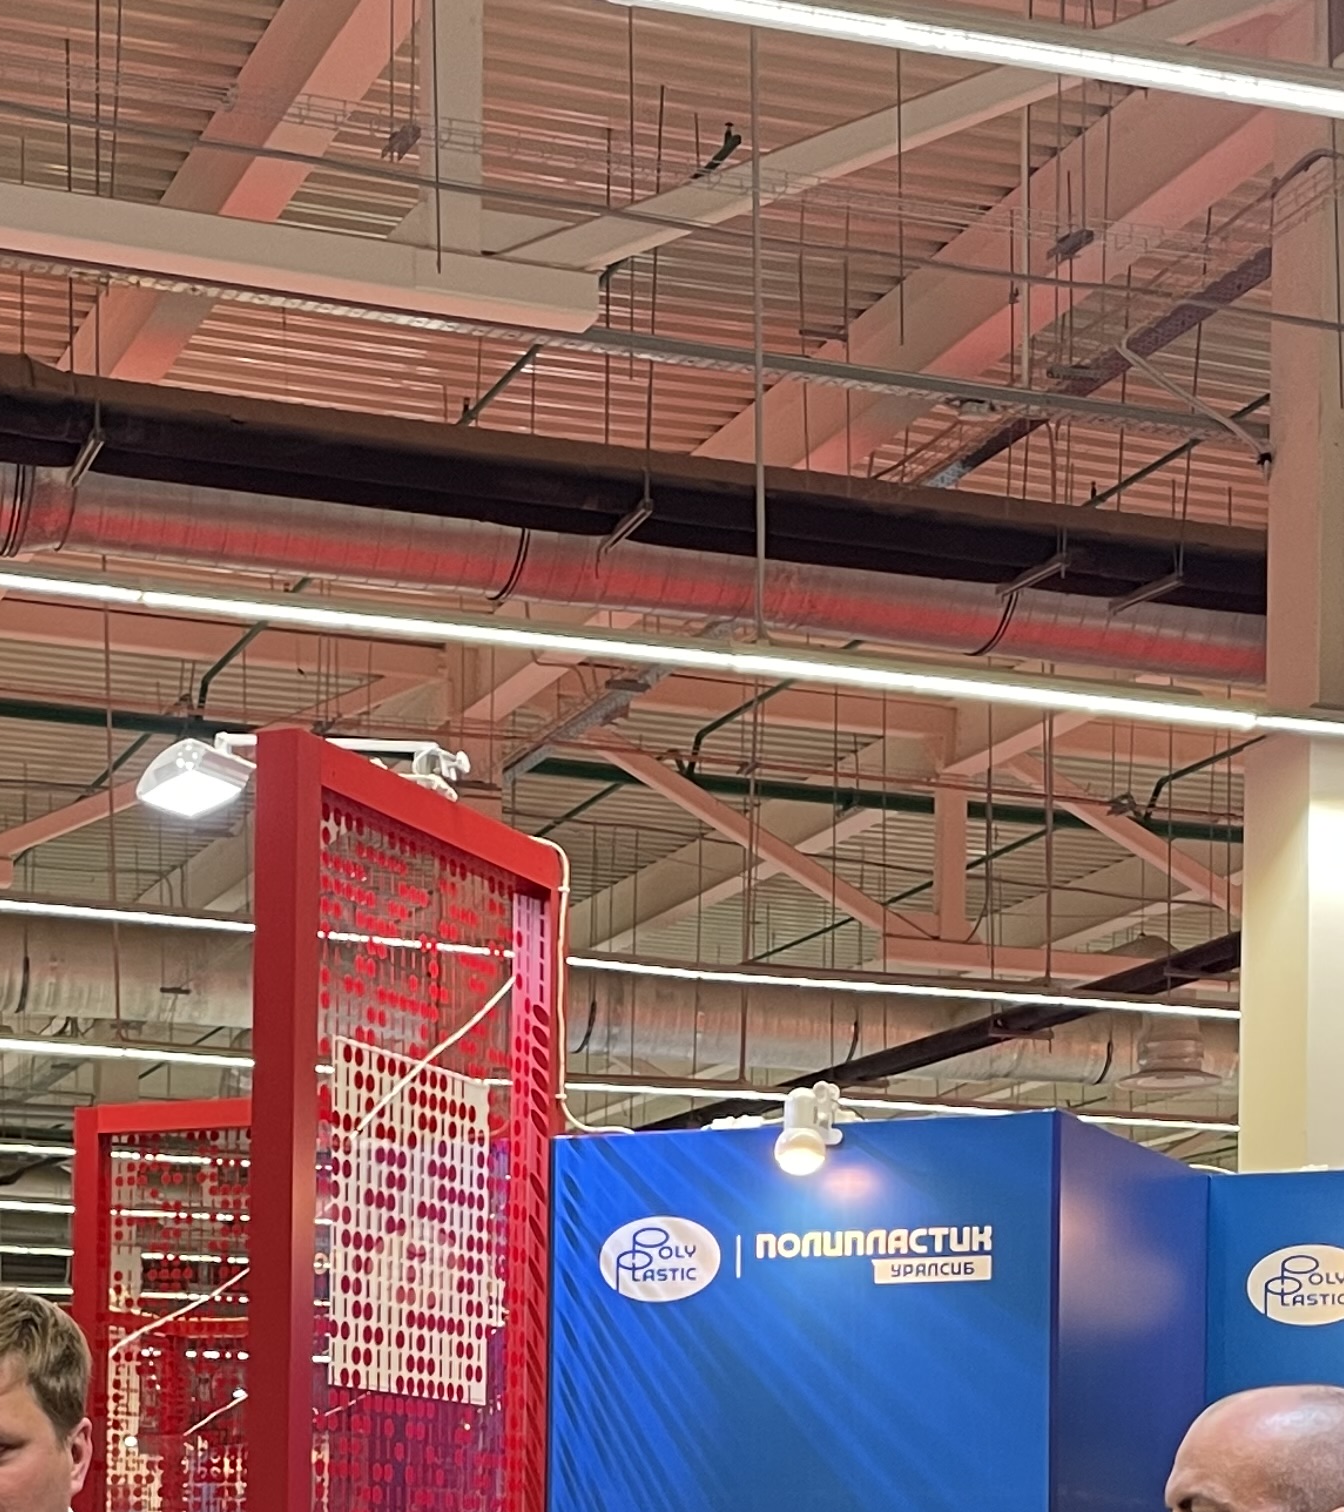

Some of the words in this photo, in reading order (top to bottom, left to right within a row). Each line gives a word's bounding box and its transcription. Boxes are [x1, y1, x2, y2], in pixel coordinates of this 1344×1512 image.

[633, 1227, 696, 1261] POLY
[756, 1225, 993, 1260] ПОЛИПЛАСТИК
[616, 1250, 697, 1293] PLASTIC
[890, 1261, 976, 1279] УРАЛСИБ
